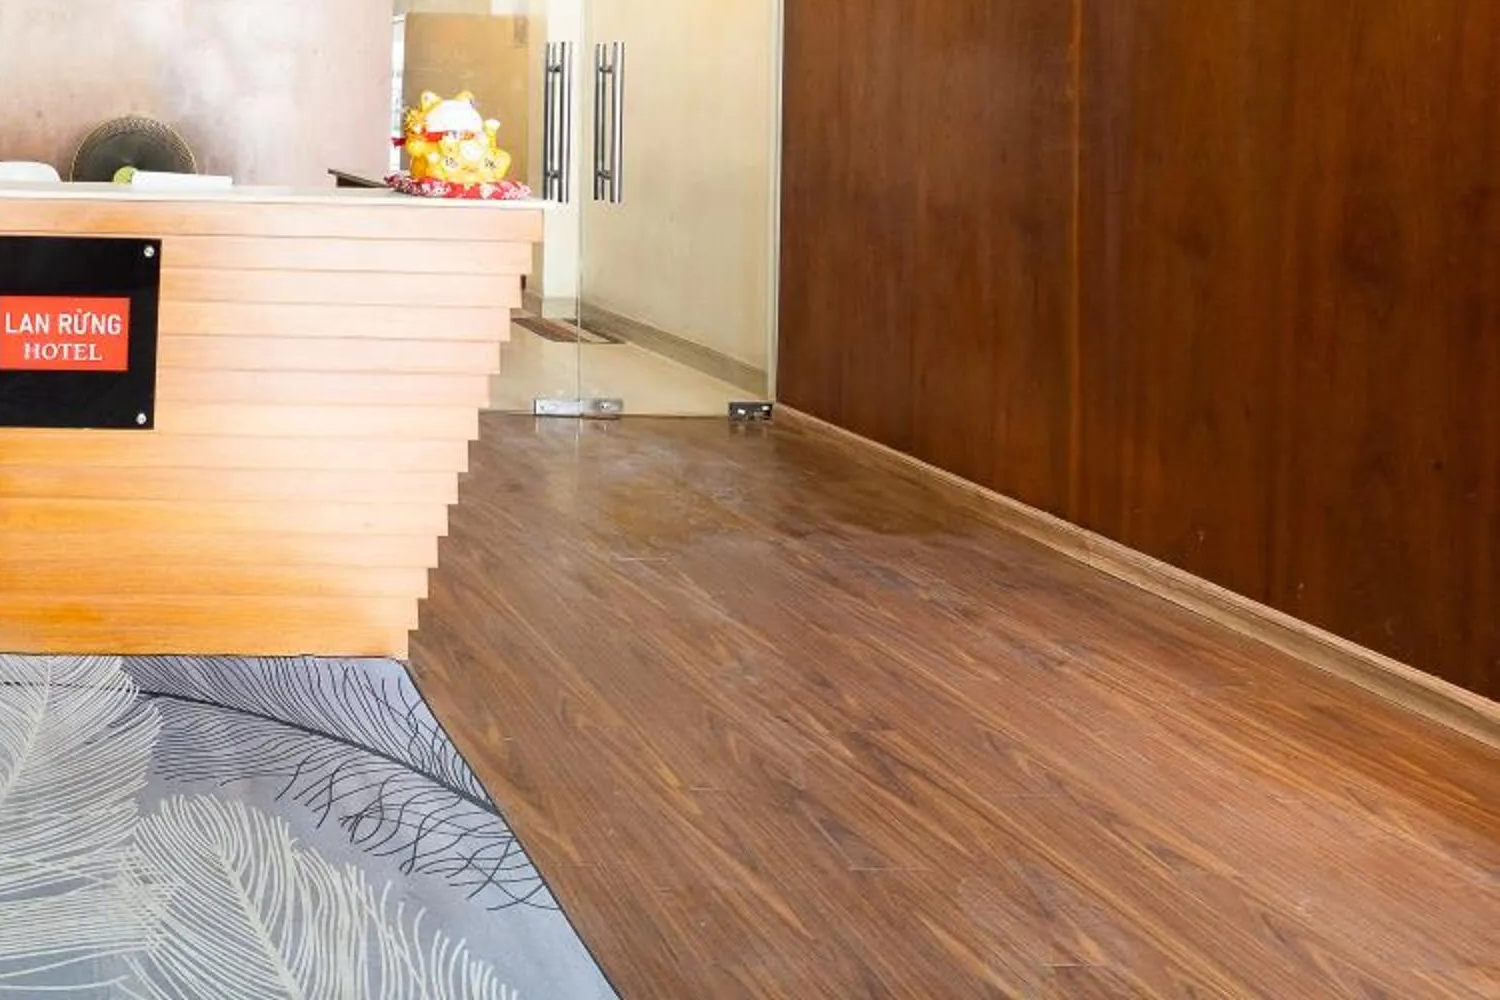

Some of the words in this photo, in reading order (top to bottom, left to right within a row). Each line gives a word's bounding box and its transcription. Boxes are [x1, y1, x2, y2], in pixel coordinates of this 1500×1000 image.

[5, 312, 50, 335] LAN
[59, 308, 122, 336] RỪNG
[23, 343, 104, 361] HOTEL
